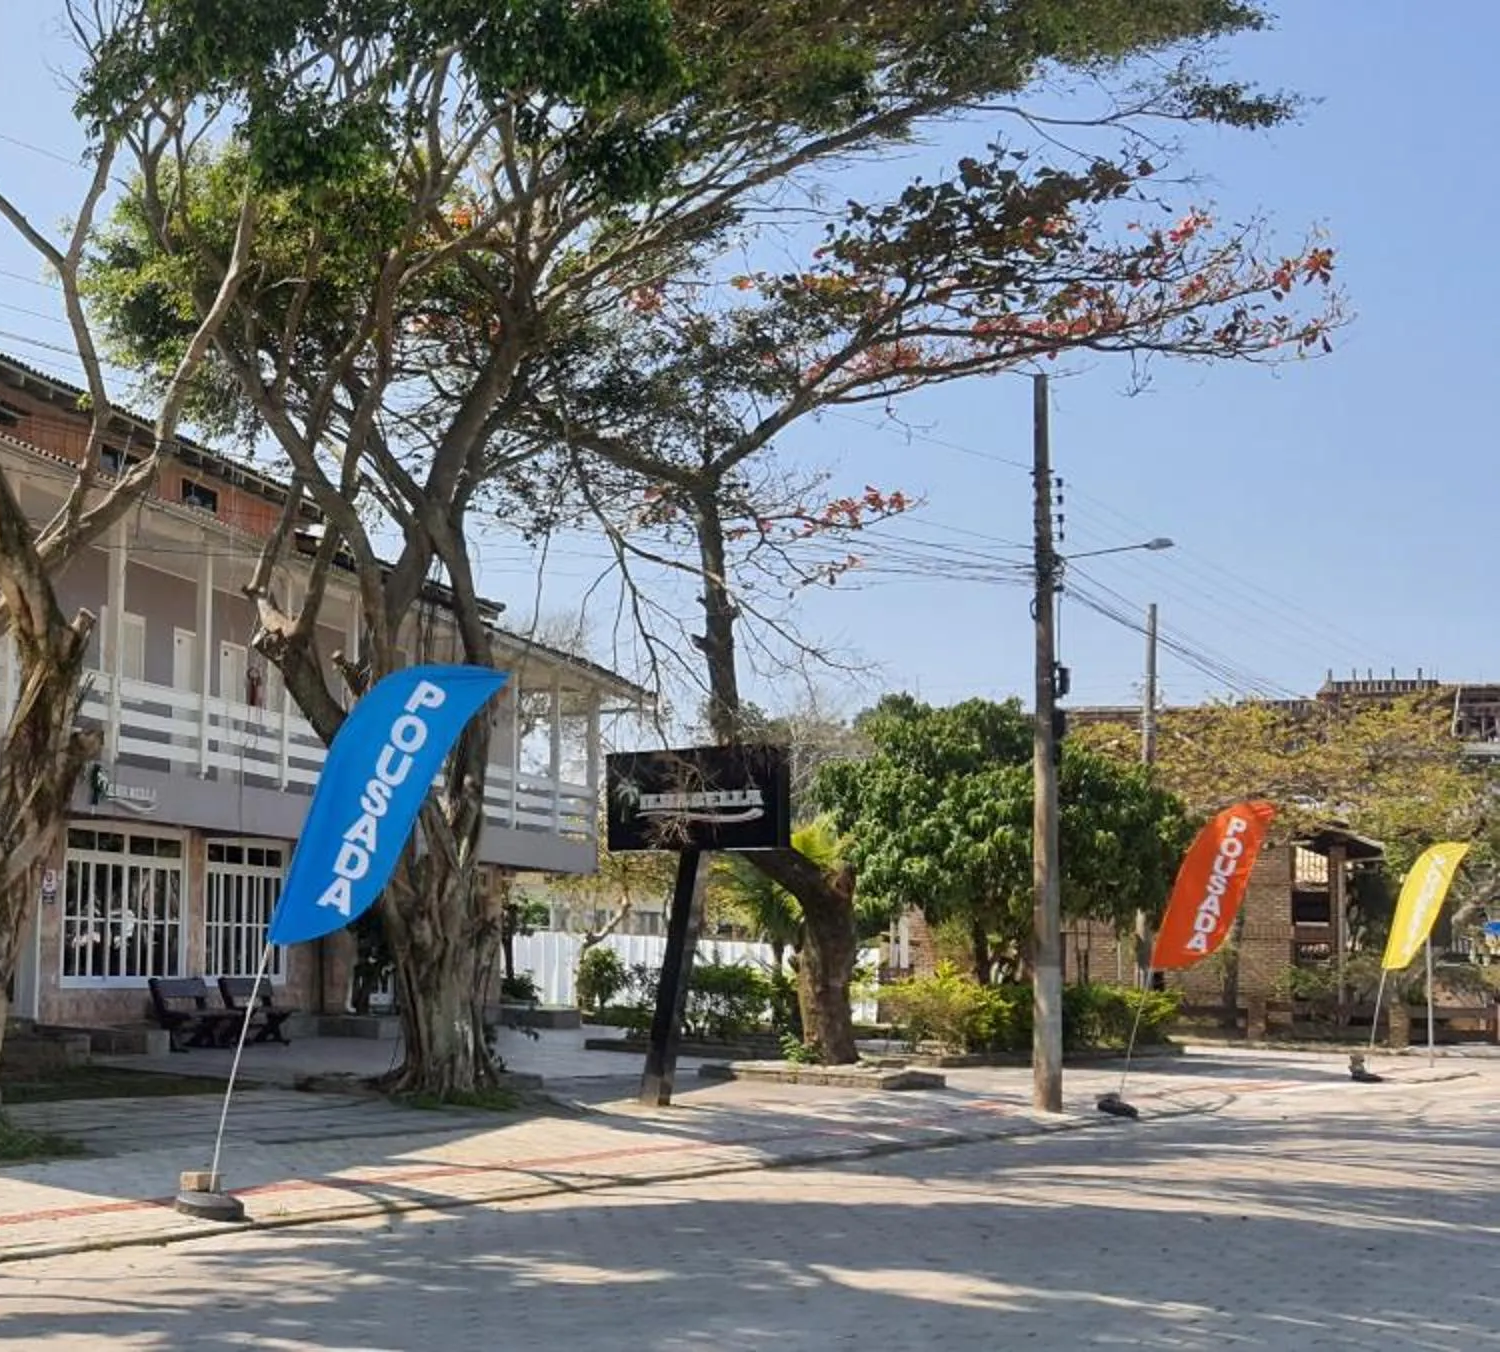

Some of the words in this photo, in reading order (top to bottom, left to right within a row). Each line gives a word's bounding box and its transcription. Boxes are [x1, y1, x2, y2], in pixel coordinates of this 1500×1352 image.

[316, 680, 446, 916] POUSADA
[692, 789, 765, 808] BELLA
[1187, 816, 1248, 951] POUSADA
